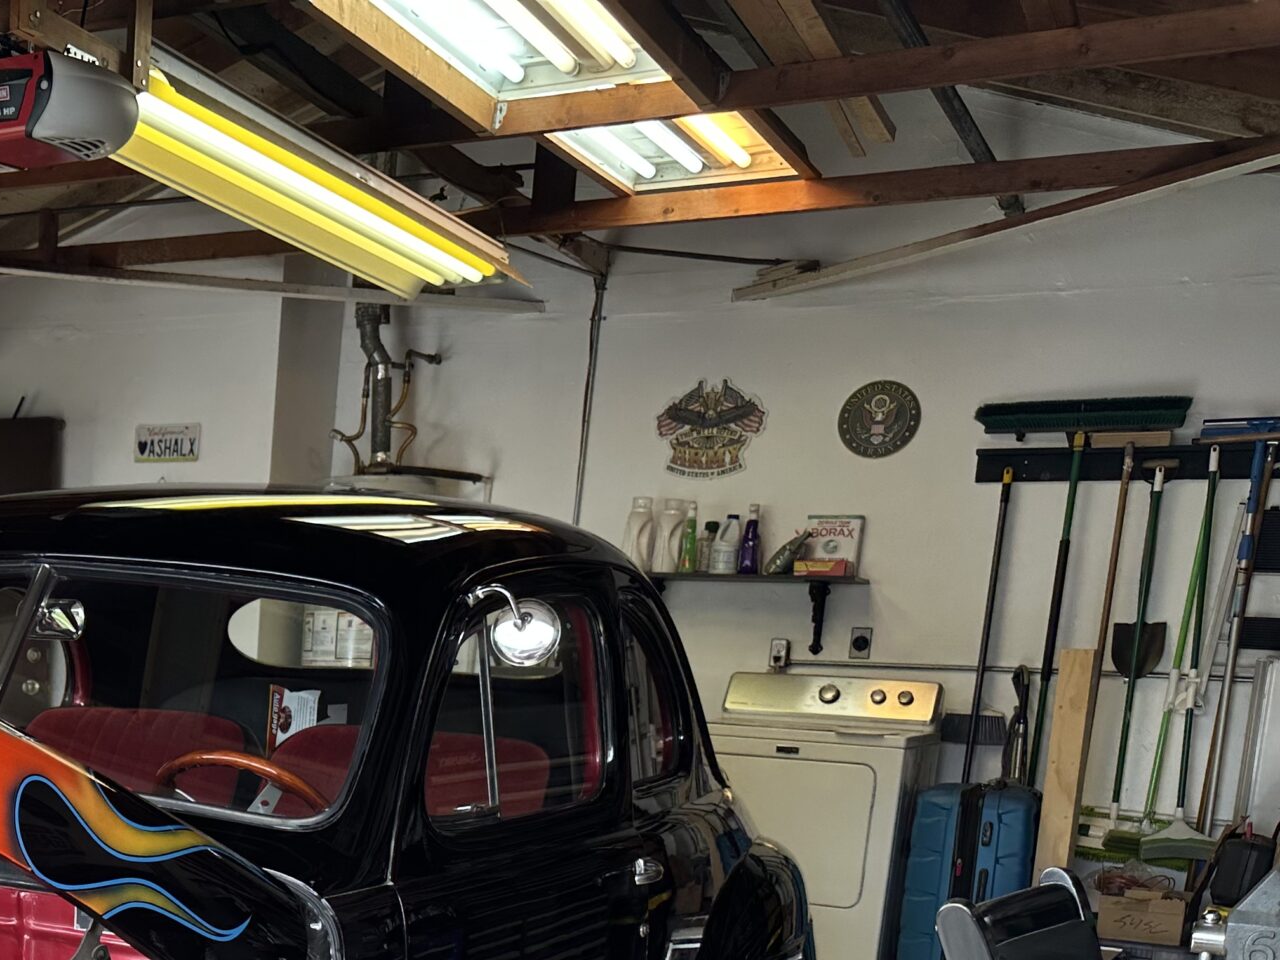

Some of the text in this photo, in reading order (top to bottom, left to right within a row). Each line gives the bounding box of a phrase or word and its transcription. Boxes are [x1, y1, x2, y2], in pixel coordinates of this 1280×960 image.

[3, 107, 16, 116] HP
[885, 383, 916, 409] STATES
[670, 442, 746, 470] ARMY
[666, 464, 686, 476] UNITED
[717, 462, 742, 476] AMERICA
[811, 527, 855, 539] BORAX
